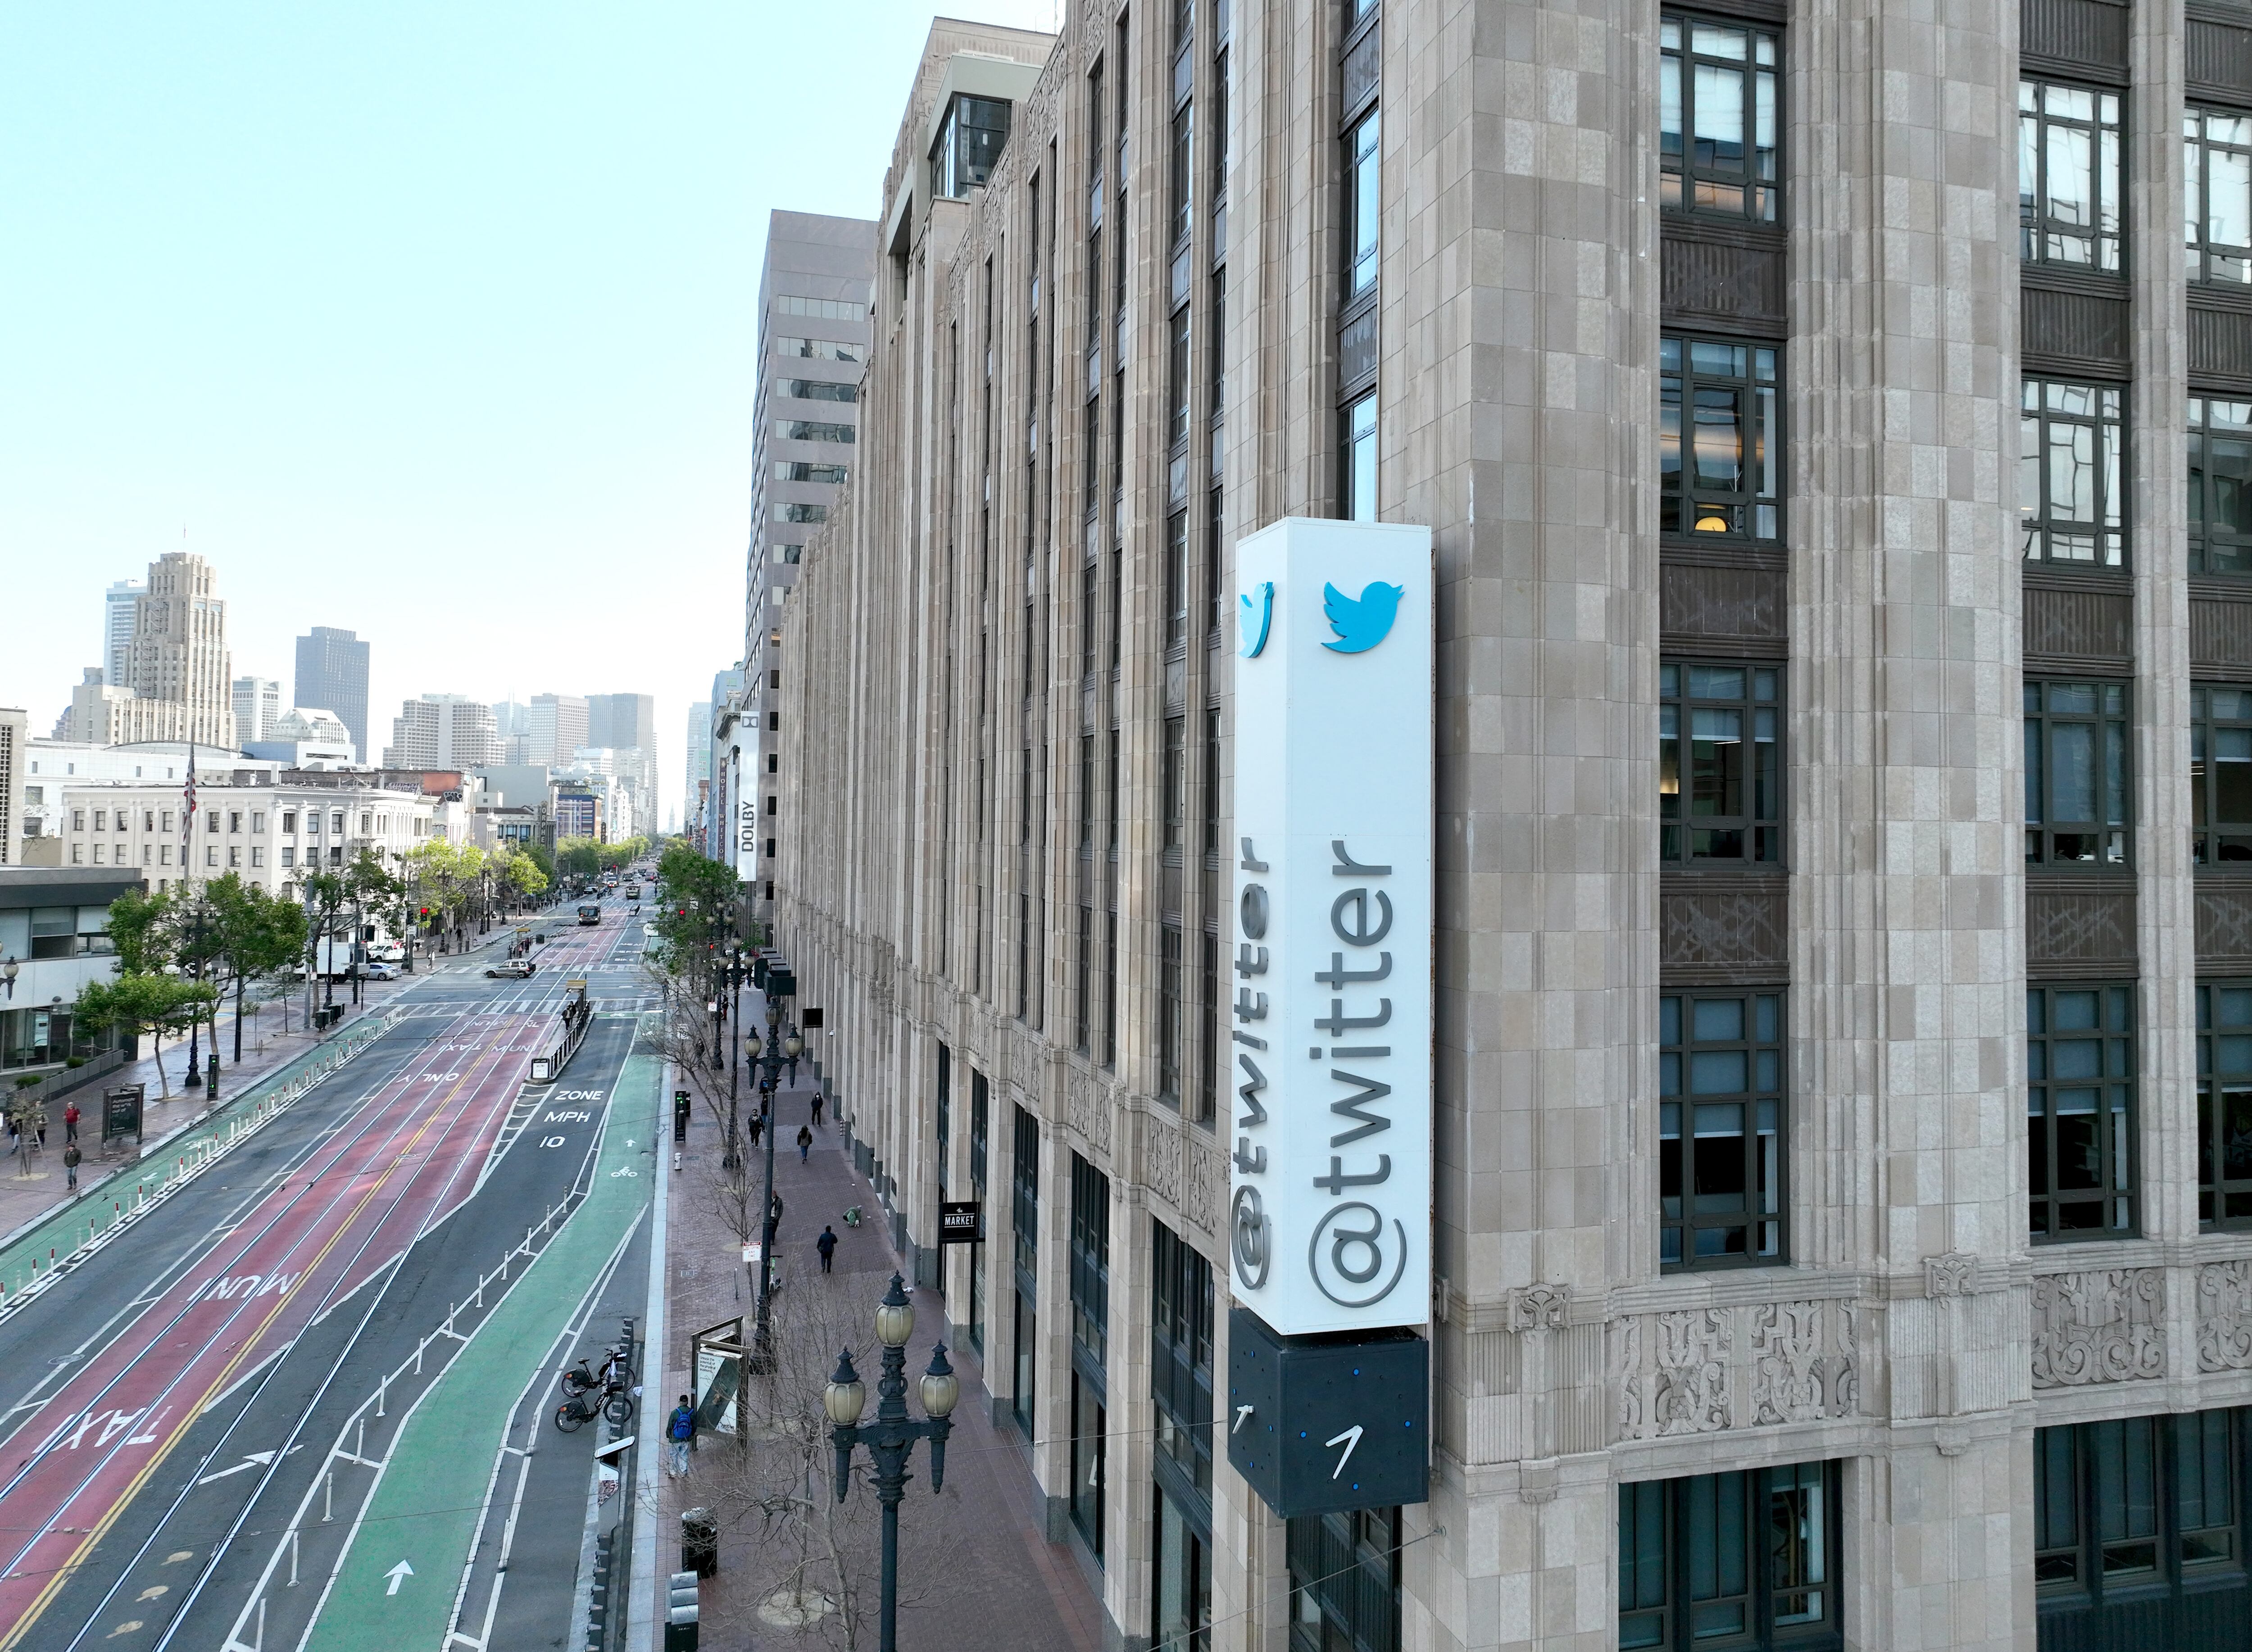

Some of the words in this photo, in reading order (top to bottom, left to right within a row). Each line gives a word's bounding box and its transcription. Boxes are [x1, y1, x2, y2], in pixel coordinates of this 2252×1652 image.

[742, 801, 754, 852] DOLBY
[438, 1043, 482, 1052] TAXI
[490, 1044, 538, 1052] MUNI
[1231, 837, 1271, 1290] @twitter
[396, 1072, 459, 1083] ONLY
[1309, 840, 1407, 1308] @twitter
[554, 1090, 604, 1100] ZONE
[544, 1111, 591, 1122] MPH
[539, 1136, 566, 1148] 10
[944, 1215, 974, 1225] MARKET
[186, 1271, 301, 1301] MUNI
[31, 1405, 173, 1454] TAXI
